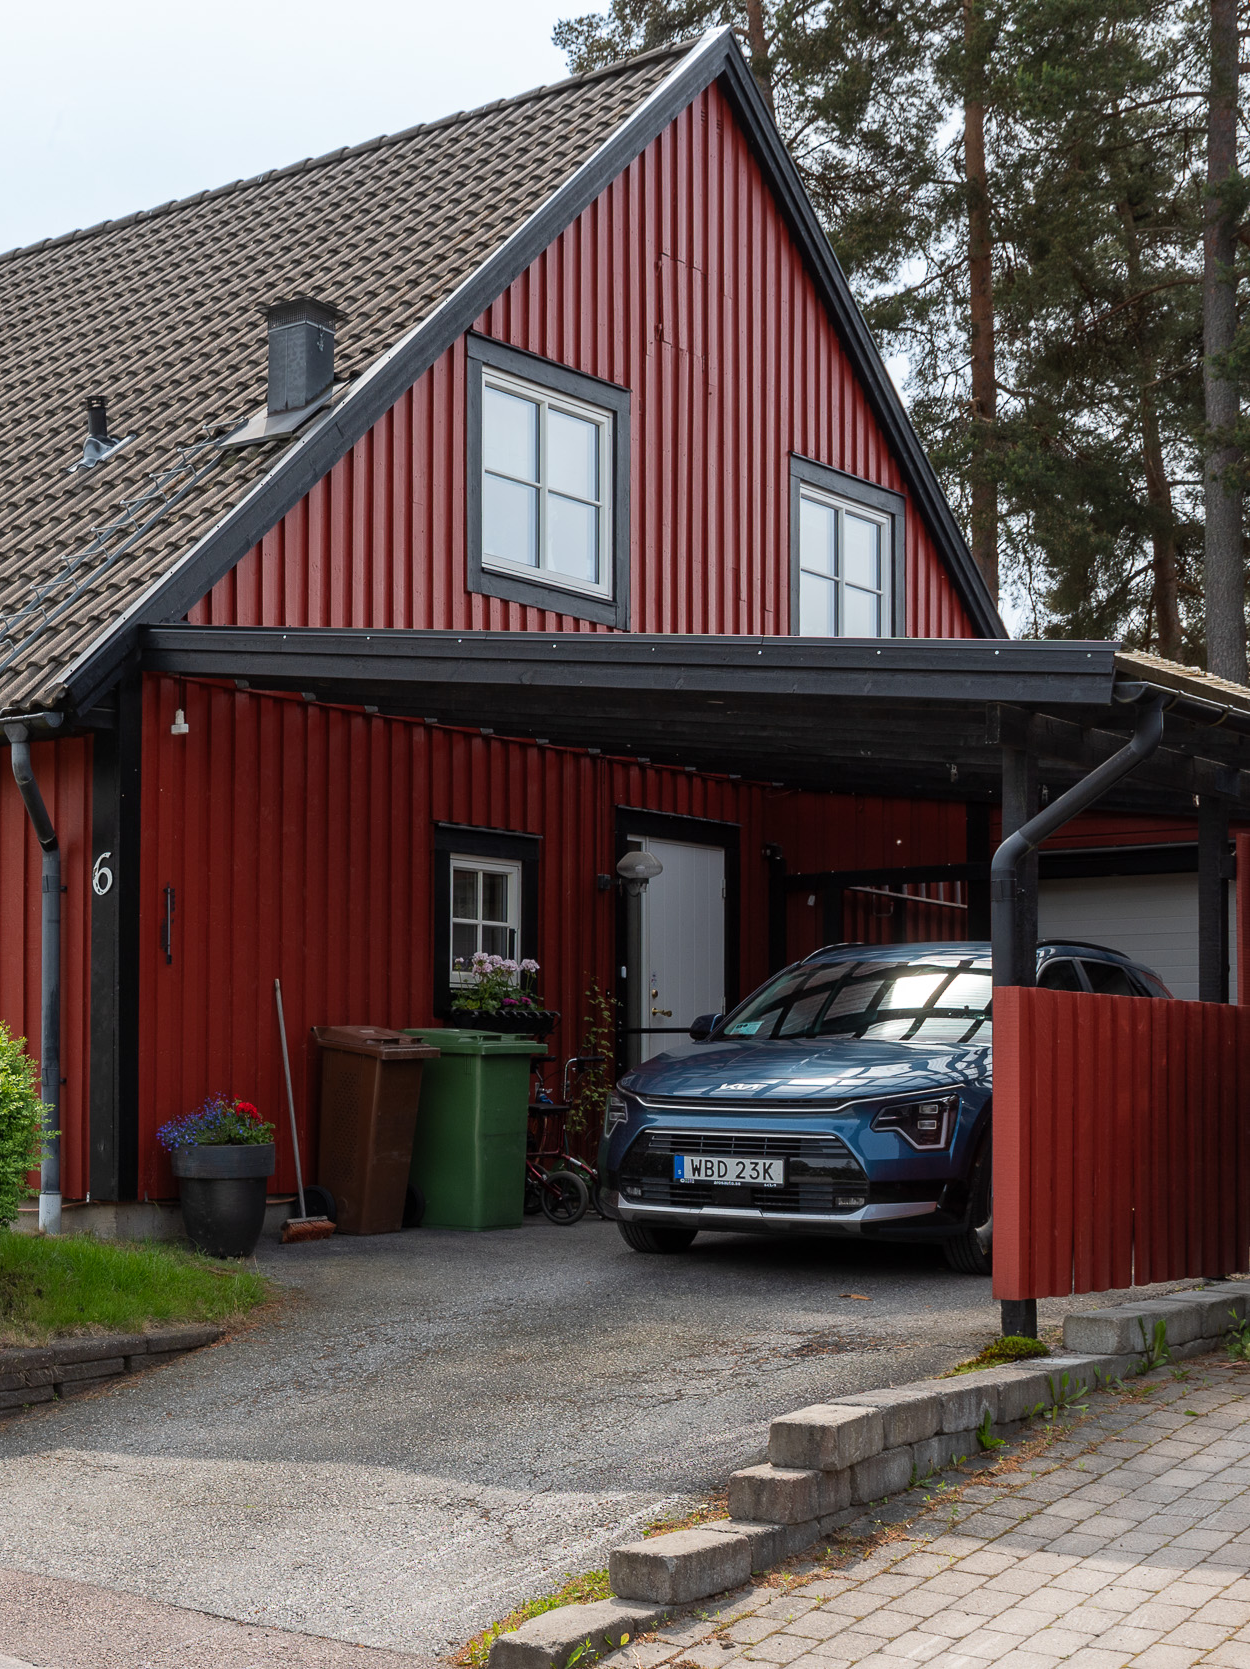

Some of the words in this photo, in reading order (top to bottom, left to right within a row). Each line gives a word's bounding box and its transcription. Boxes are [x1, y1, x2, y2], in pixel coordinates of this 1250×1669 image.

[92, 851, 113, 896] 6
[690, 1158, 728, 1179] WBD
[734, 1160, 774, 1181] 23K
